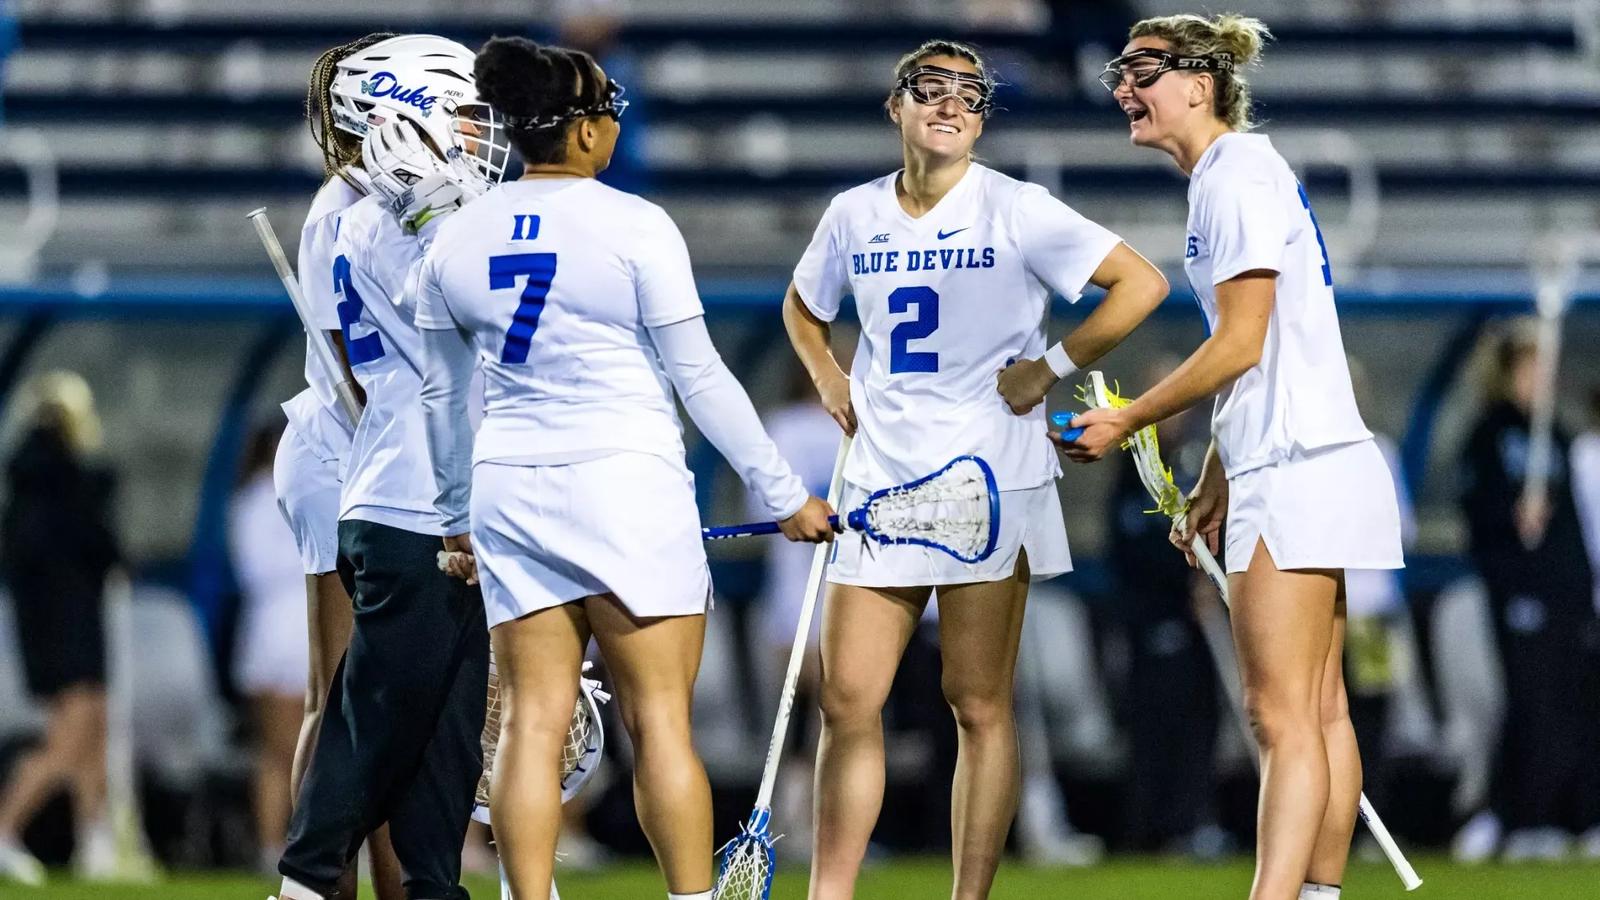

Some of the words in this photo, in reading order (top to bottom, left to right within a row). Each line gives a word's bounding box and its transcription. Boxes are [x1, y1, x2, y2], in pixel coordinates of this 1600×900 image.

[1178, 58, 1210, 68] STX
[369, 71, 438, 111] Duke
[444, 89, 465, 98] AERO
[868, 233, 891, 243] ACC
[853, 251, 899, 275] BLUE
[907, 247, 996, 272] DEVILS
[332, 253, 386, 367] 2
[489, 252, 557, 364] 7
[888, 285, 939, 374] 2
